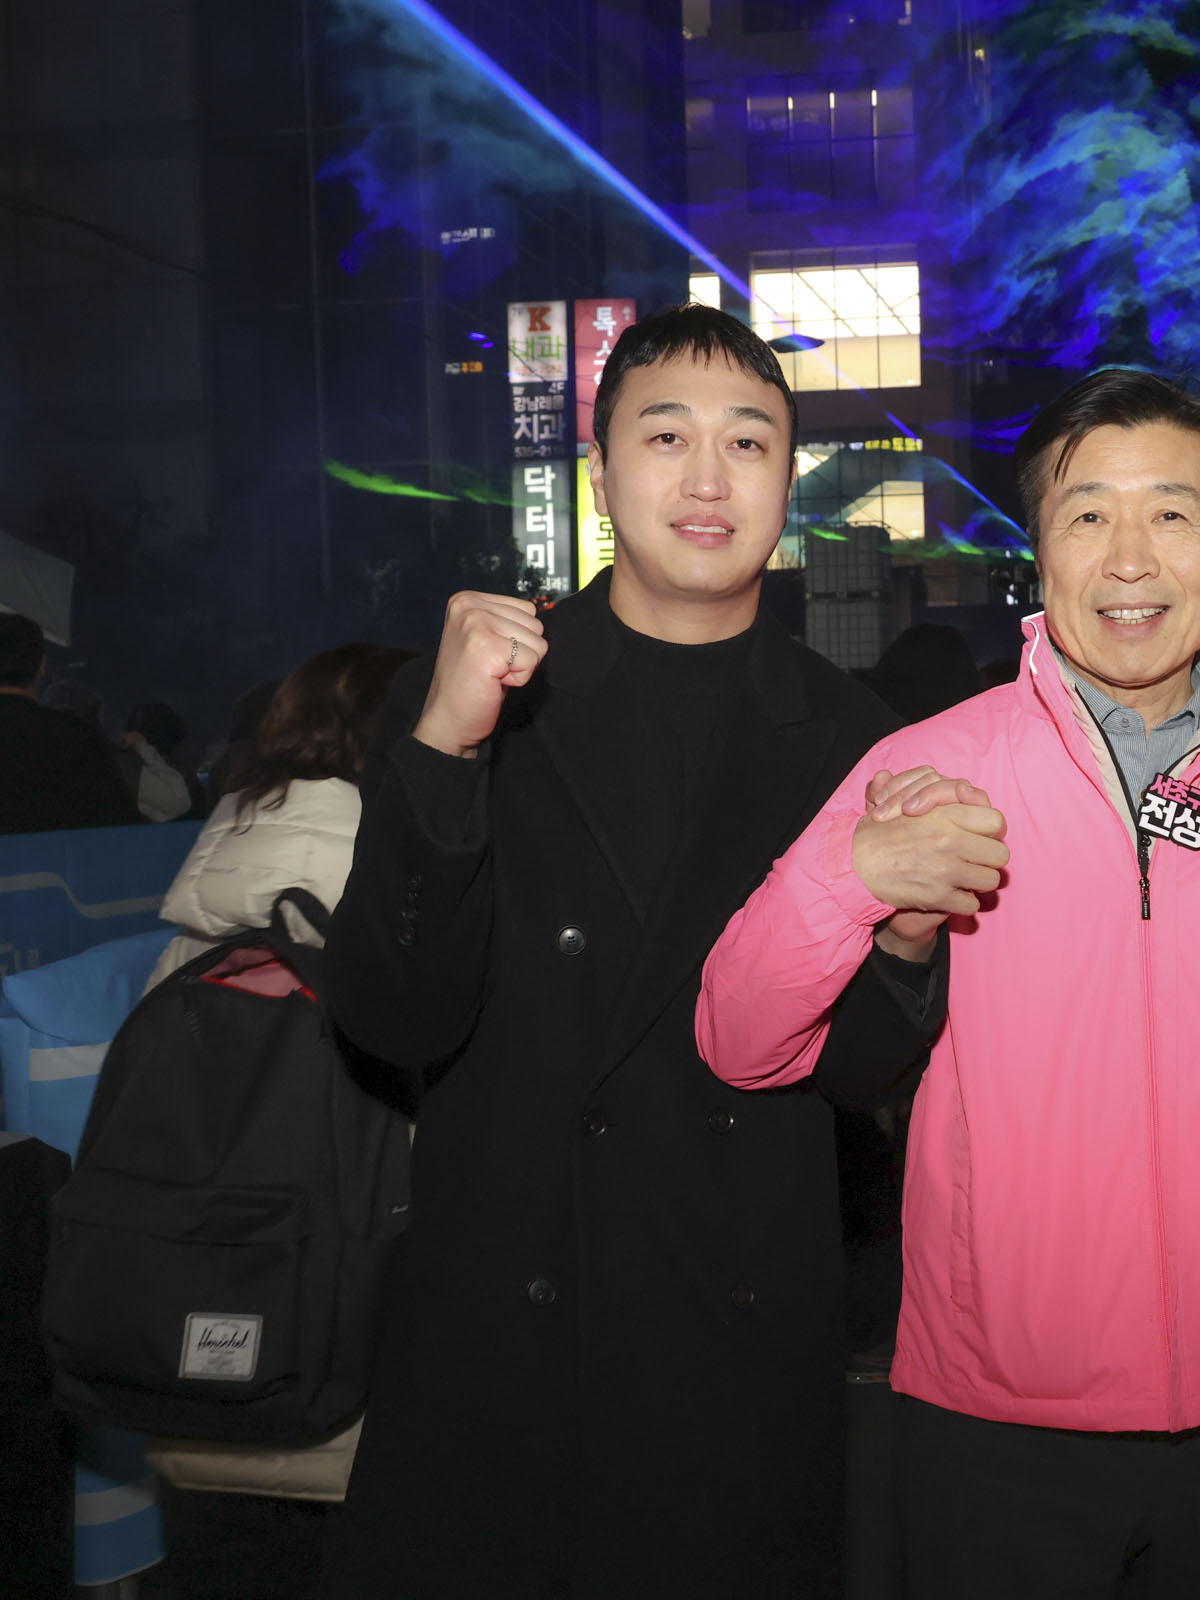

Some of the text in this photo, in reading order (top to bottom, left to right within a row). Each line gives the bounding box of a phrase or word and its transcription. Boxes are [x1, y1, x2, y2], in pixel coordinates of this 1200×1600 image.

[528, 305, 552, 332] K
[511, 335, 562, 362] 내과
[513, 413, 565, 443] 치과
[524, 464, 556, 576] 닥터미
